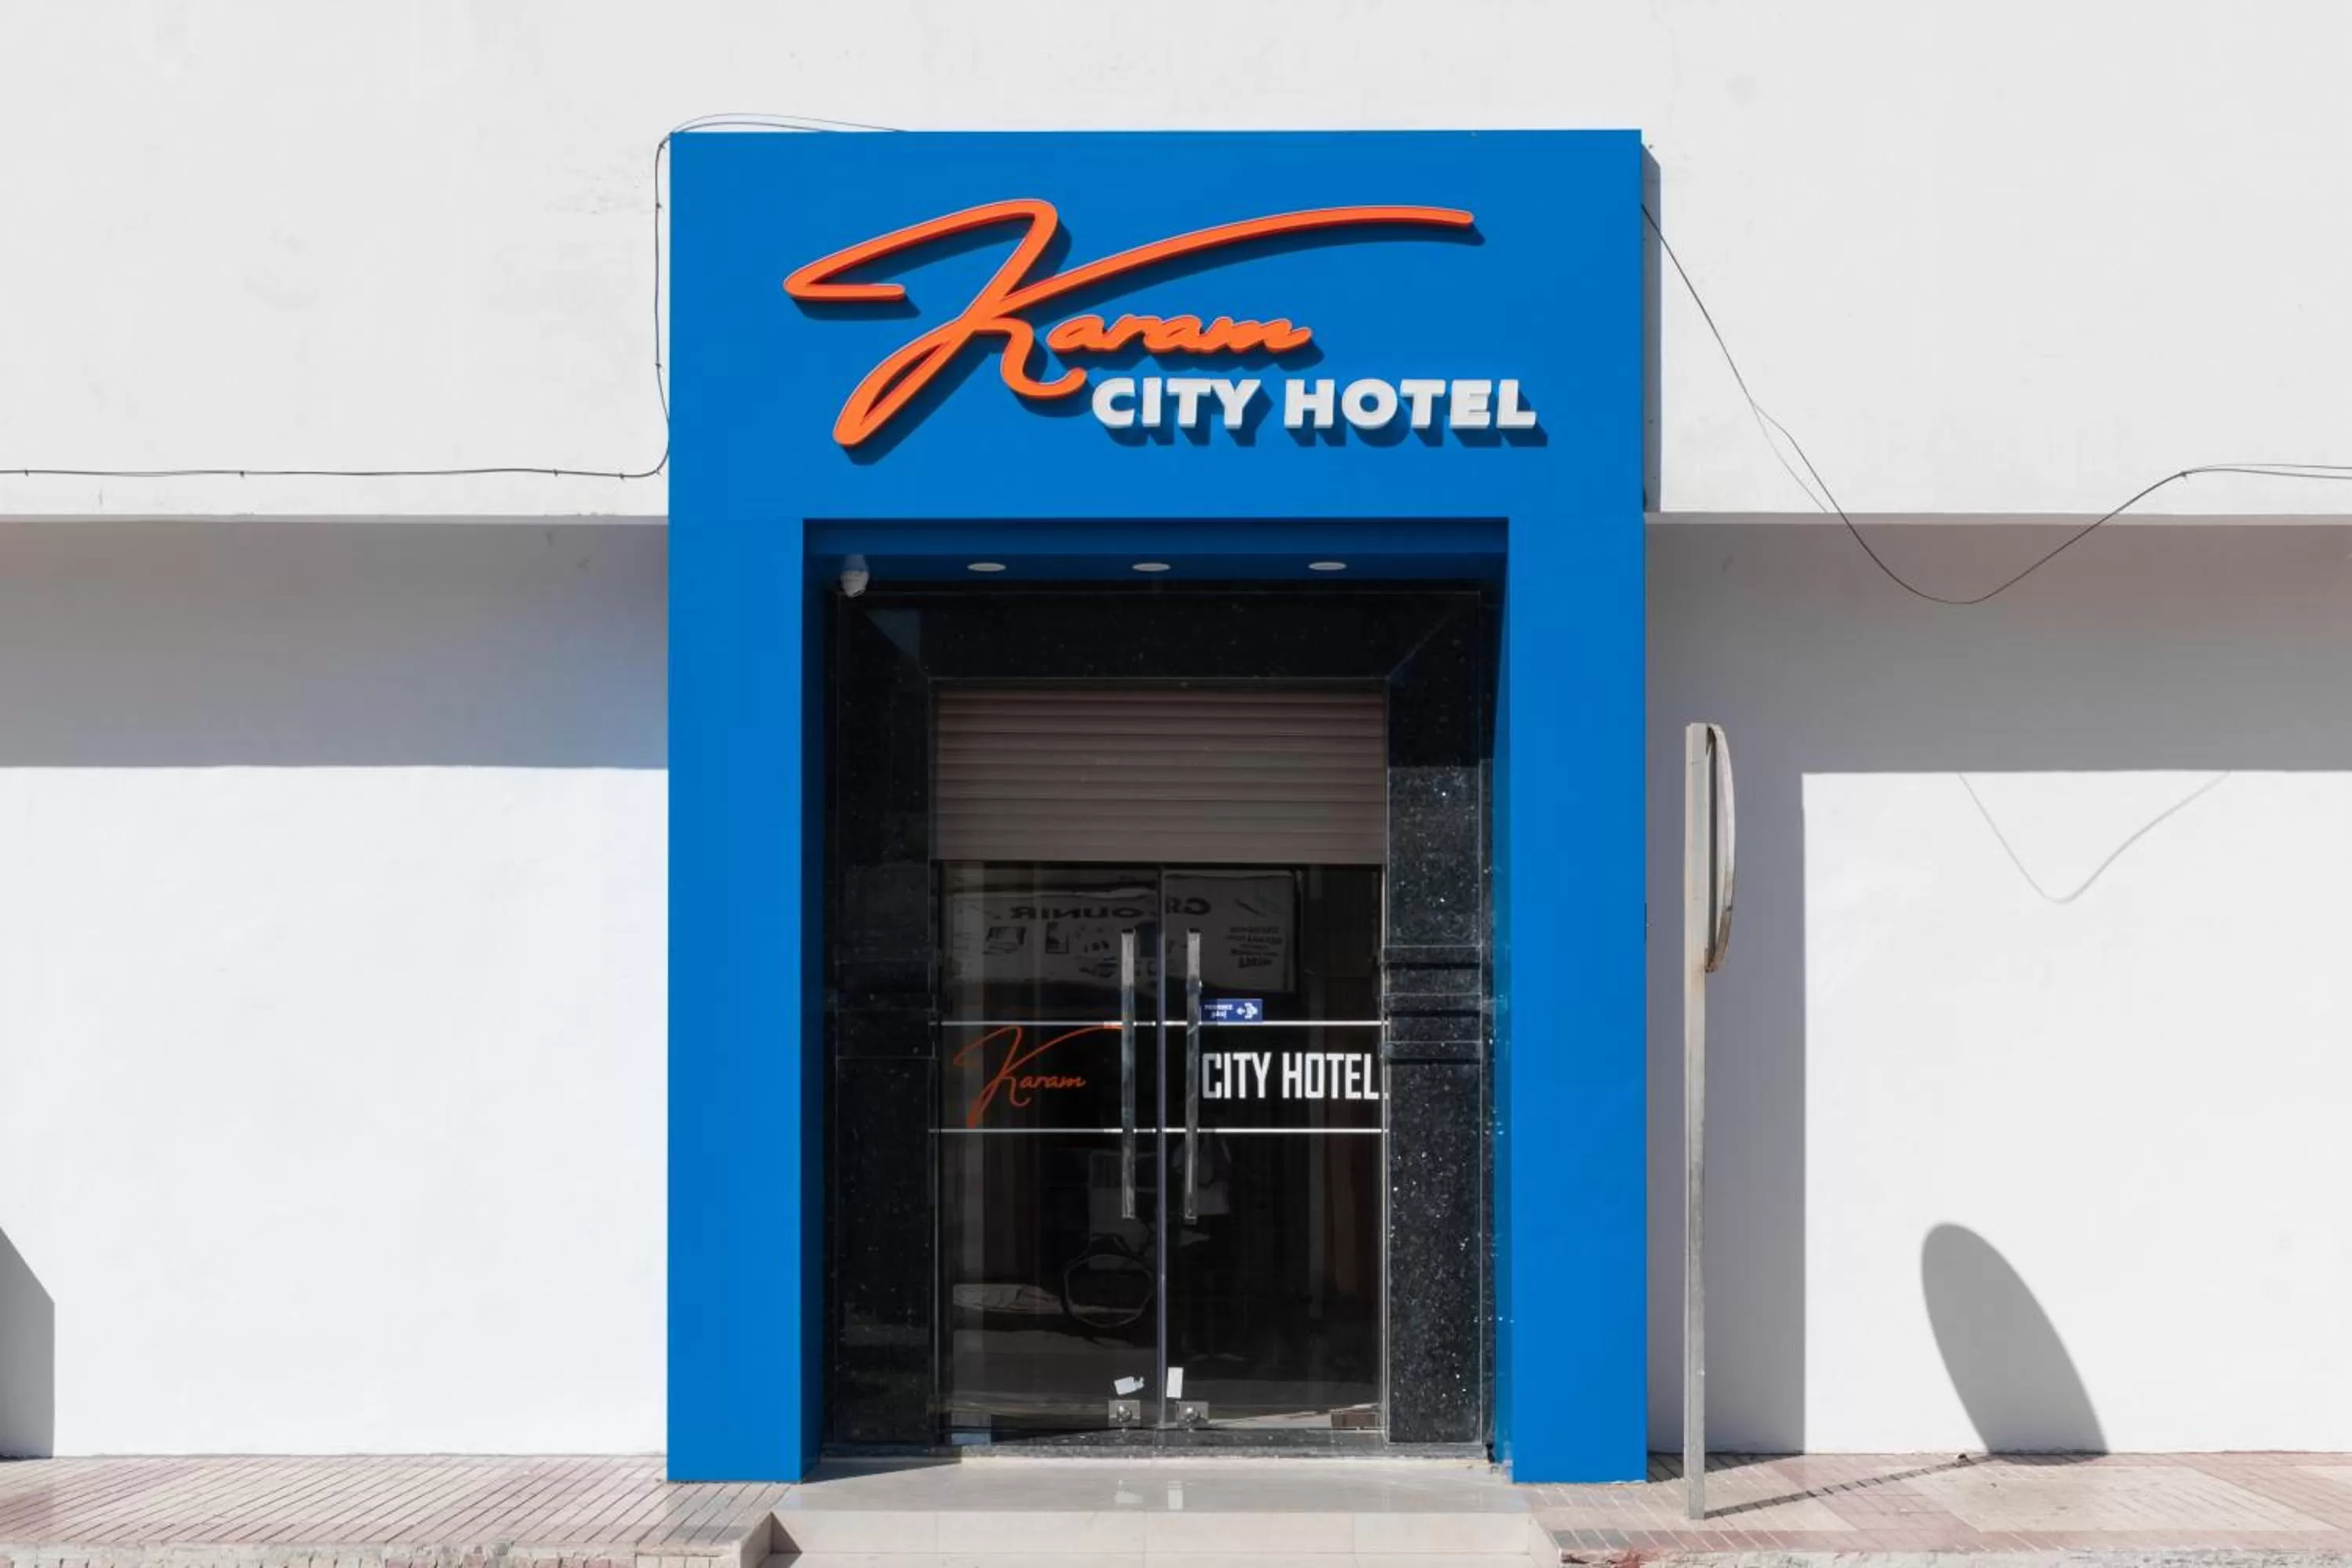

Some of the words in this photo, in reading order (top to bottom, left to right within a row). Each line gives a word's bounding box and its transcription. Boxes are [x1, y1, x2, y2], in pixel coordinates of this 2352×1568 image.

[785, 199, 1472, 447] Karam
[1092, 378, 1261, 427] CITY
[1283, 378, 1536, 428] HOTEL
[953, 1023, 1124, 1130] Karam
[1203, 1052, 1272, 1099] CITY
[1282, 1052, 1380, 1100] HOTEL
